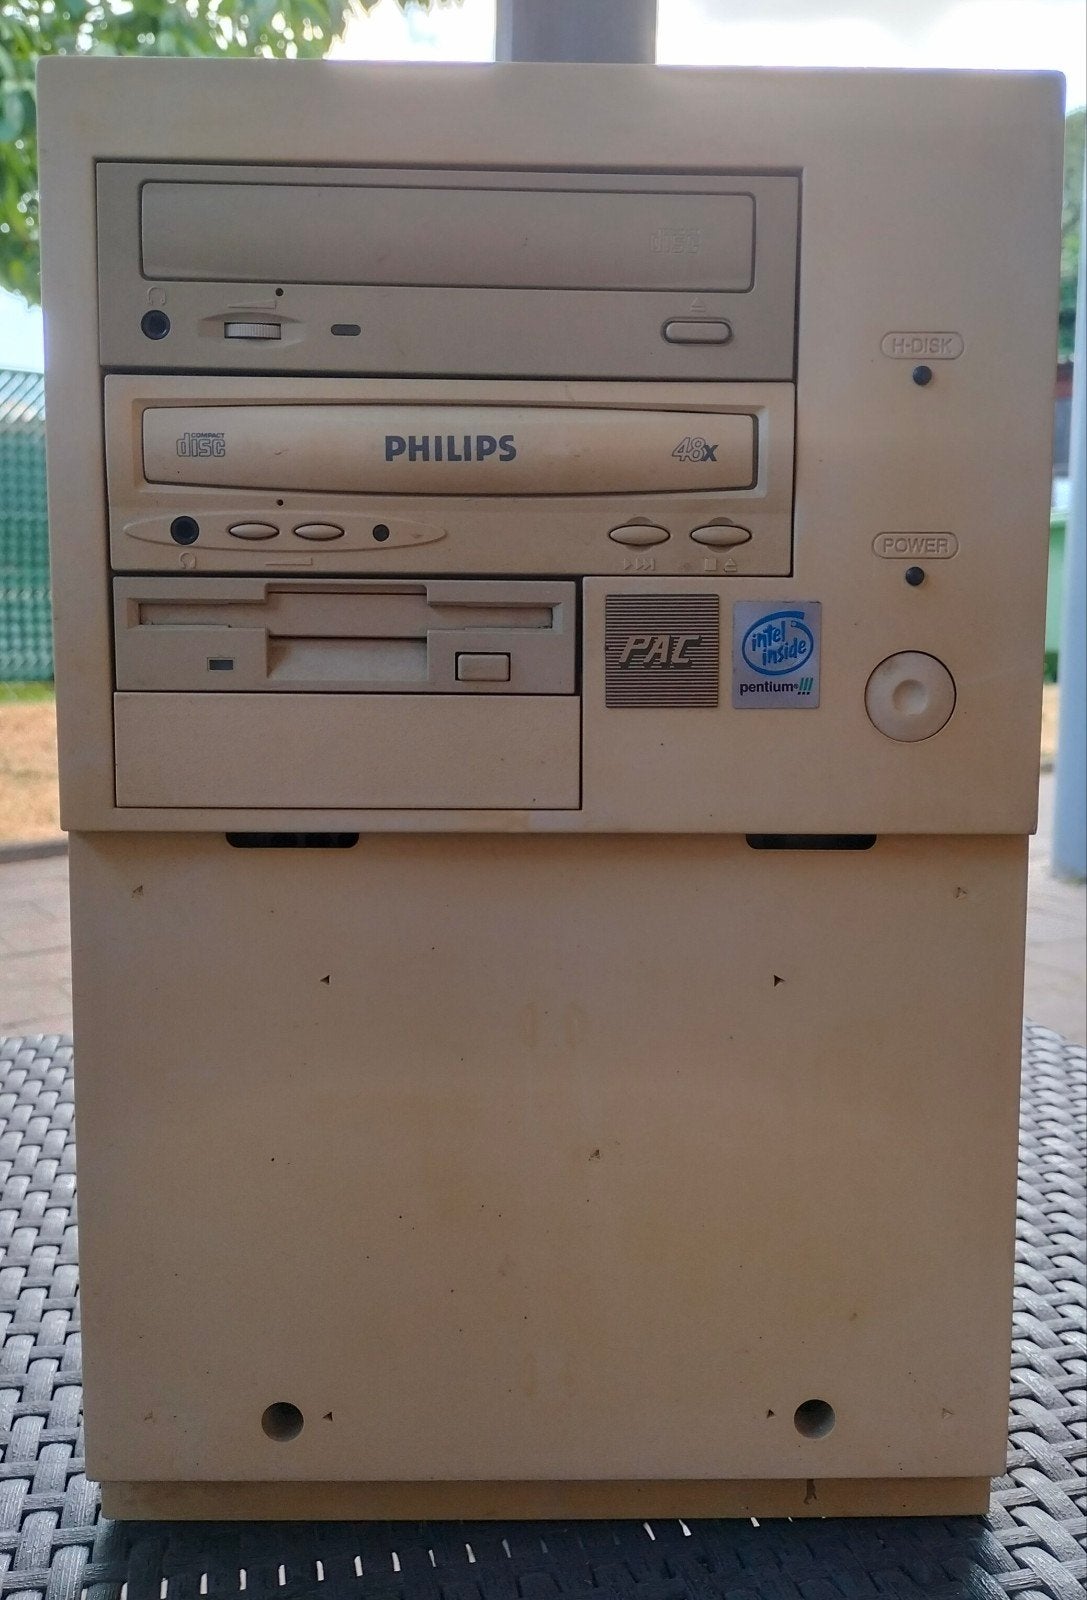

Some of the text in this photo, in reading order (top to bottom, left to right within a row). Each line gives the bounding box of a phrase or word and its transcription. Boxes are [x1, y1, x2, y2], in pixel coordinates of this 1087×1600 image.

[893, 338, 953, 354] H-DISK
[176, 432, 226, 457] disc
[385, 435, 517, 461] PHILIPS
[884, 538, 949, 553] POWER
[752, 621, 786, 651] intel
[619, 635, 702, 669] PAC
[762, 637, 806, 666] inside
